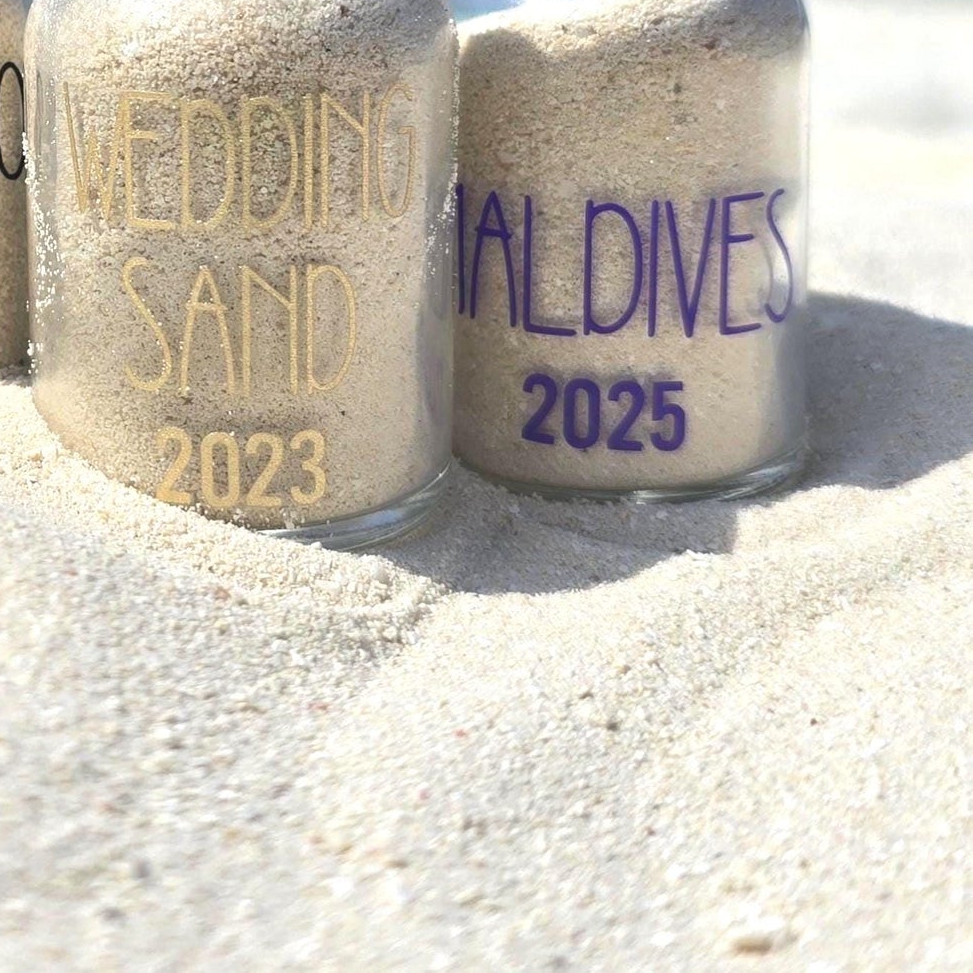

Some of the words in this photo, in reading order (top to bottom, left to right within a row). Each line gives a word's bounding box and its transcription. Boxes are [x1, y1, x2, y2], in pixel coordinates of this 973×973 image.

[63, 81, 417, 230] WEDDING
[121, 256, 358, 396] SAND
[521, 372, 686, 452] 2025
[155, 428, 328, 509] 2023
